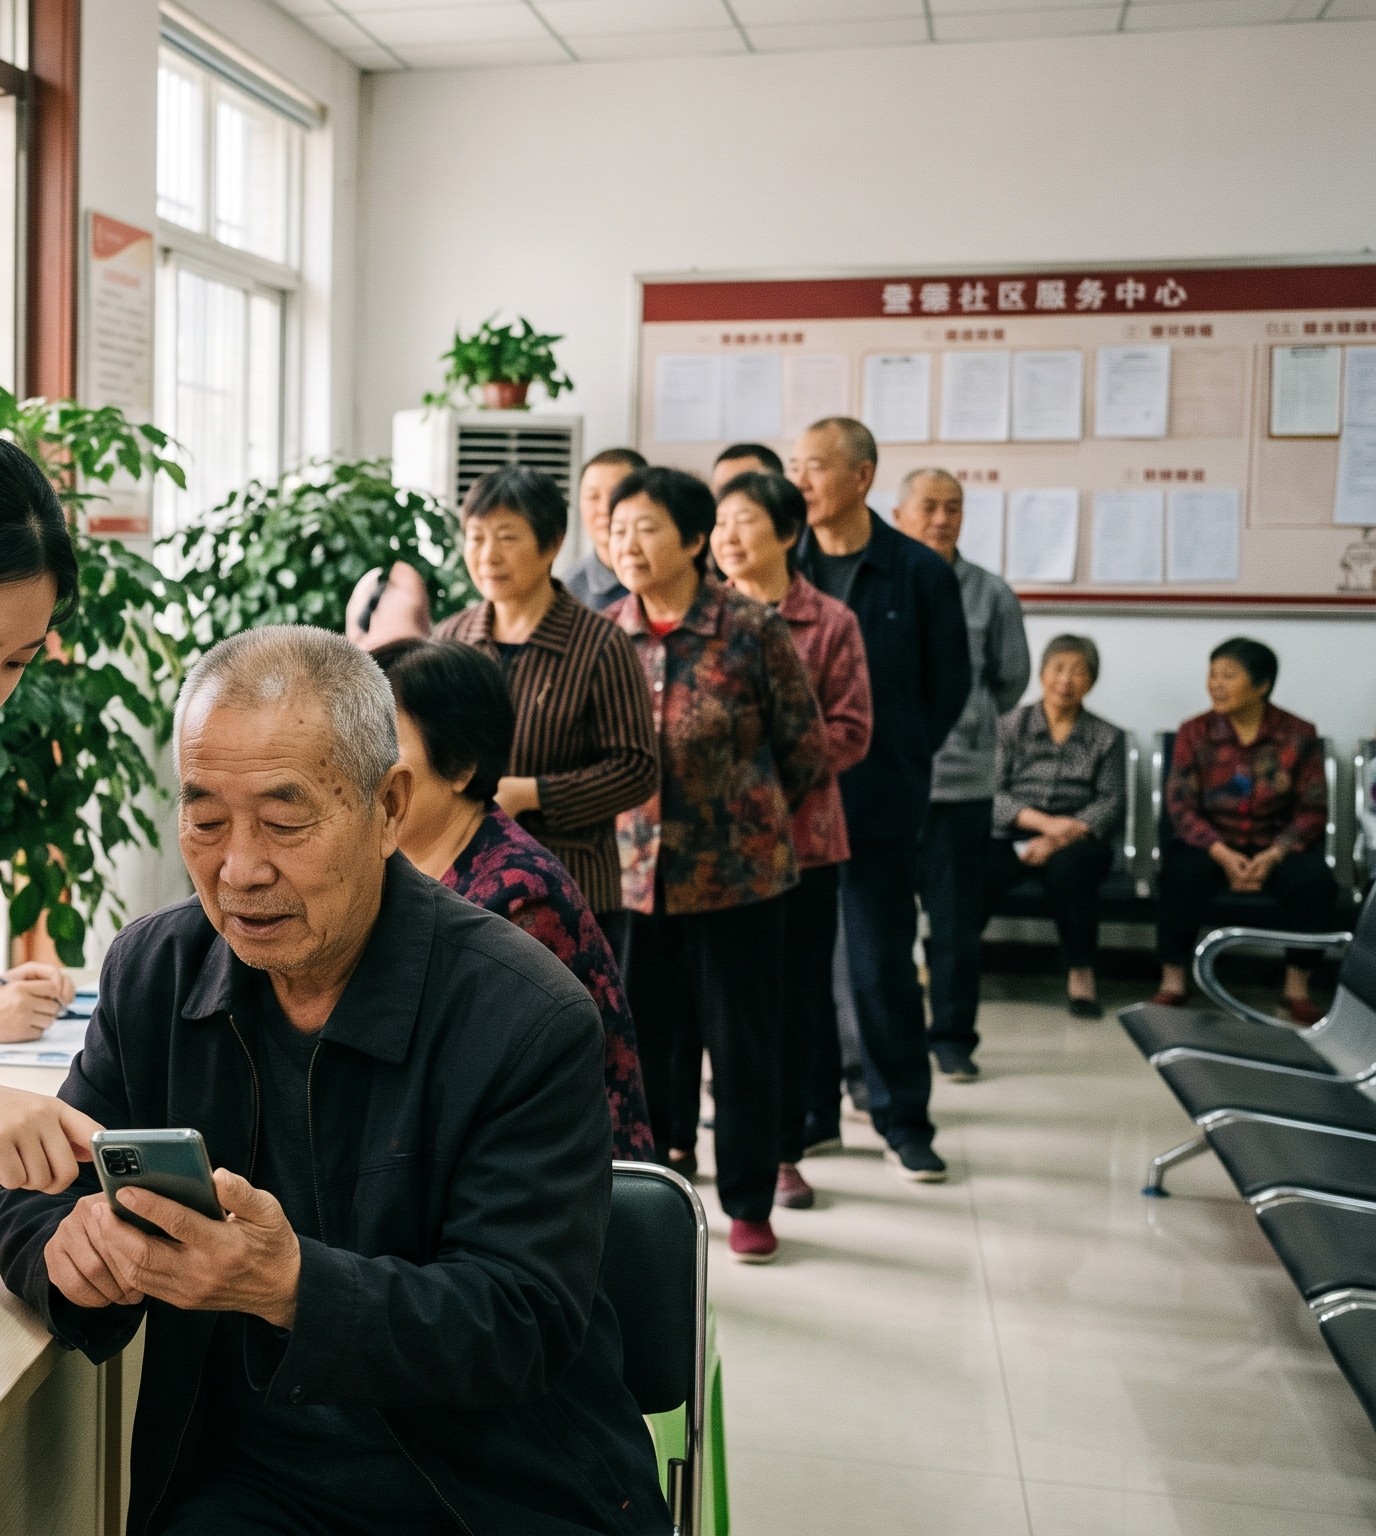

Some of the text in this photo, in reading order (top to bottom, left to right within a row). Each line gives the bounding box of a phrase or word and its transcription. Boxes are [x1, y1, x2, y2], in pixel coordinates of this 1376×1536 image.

[882, 278, 1188, 315] 社区服务中心
